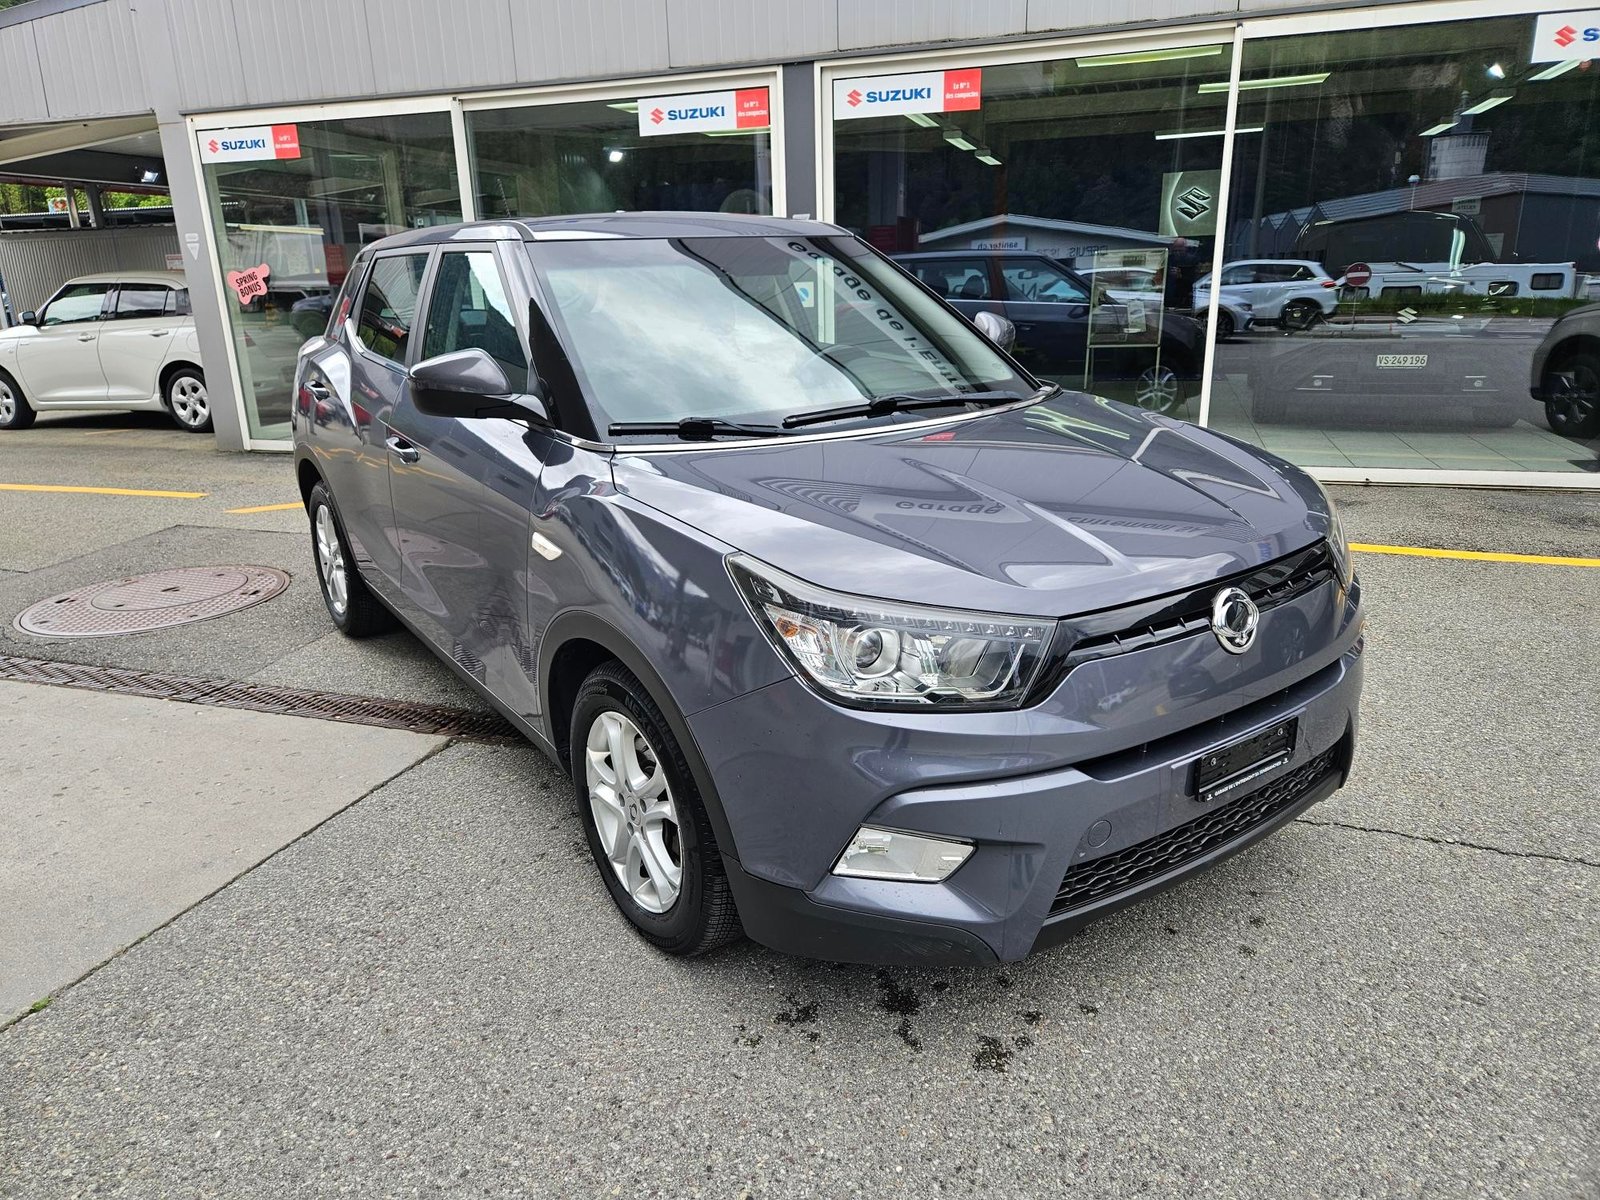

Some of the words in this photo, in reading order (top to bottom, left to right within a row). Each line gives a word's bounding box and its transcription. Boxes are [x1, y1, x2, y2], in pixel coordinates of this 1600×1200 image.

[866, 87, 931, 103] SUZUKI
[667, 106, 725, 121] SUZUKI
[221, 139, 266, 151] SUZUKI
[236, 271, 258, 288] SPRING
[240, 281, 262, 298] BONUS
